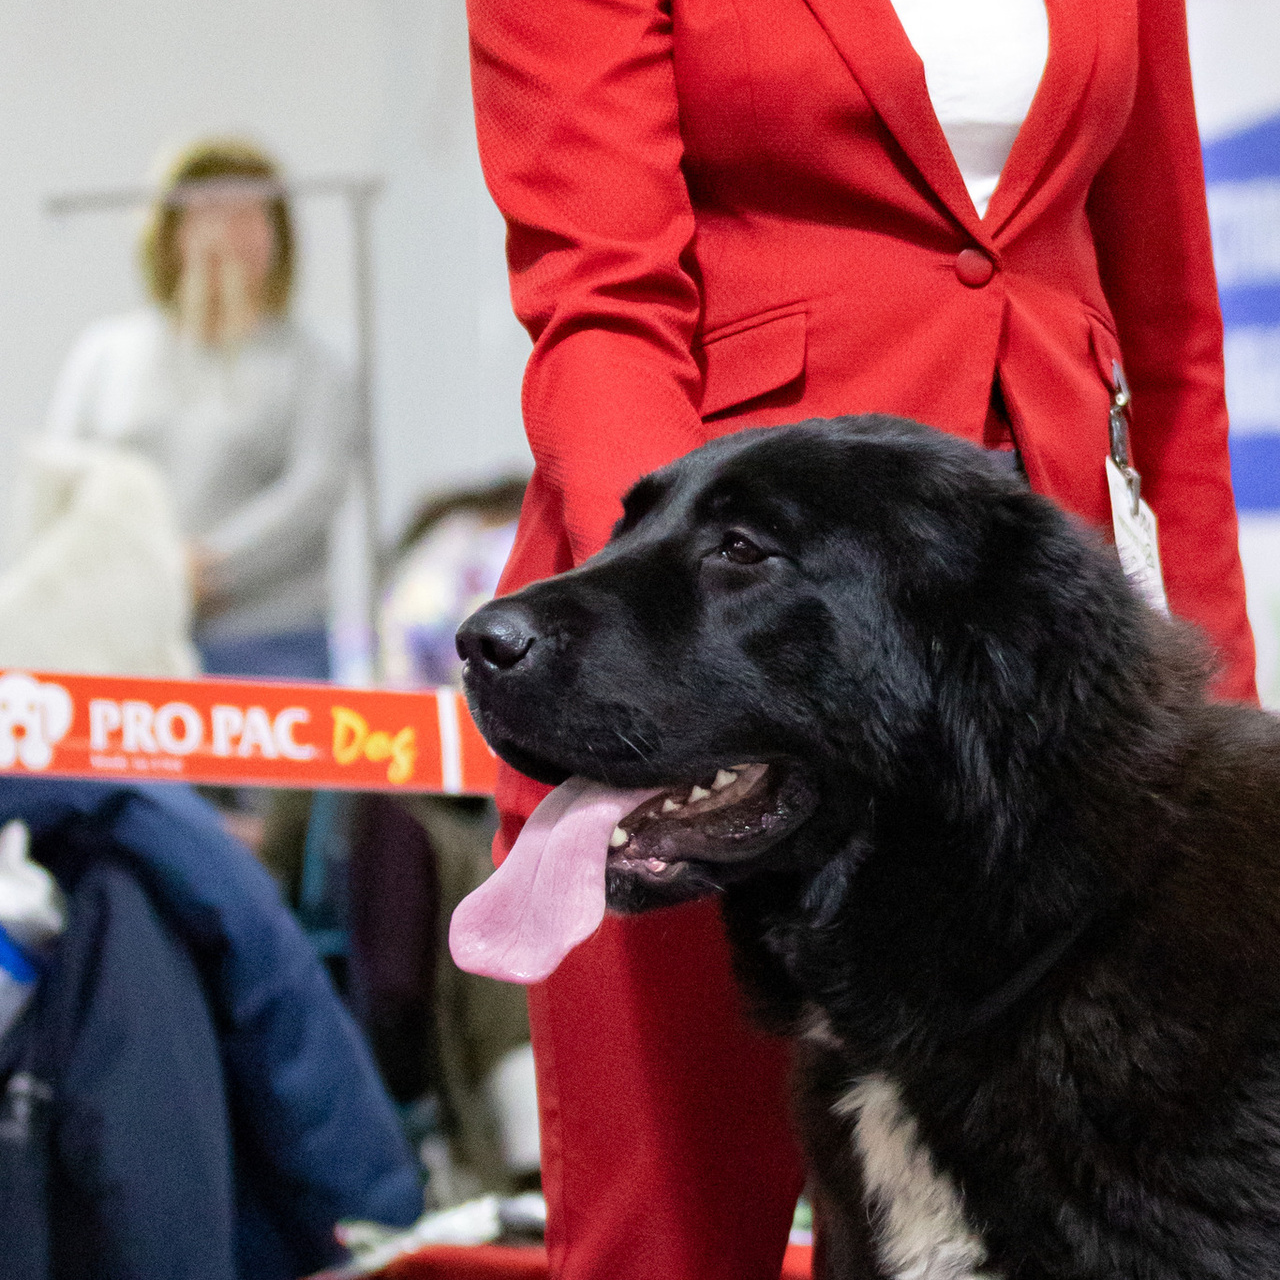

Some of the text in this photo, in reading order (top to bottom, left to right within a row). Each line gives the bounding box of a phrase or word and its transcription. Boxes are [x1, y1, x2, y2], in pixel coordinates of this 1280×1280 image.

[90, 698, 416, 784] PRO PAC Dog
